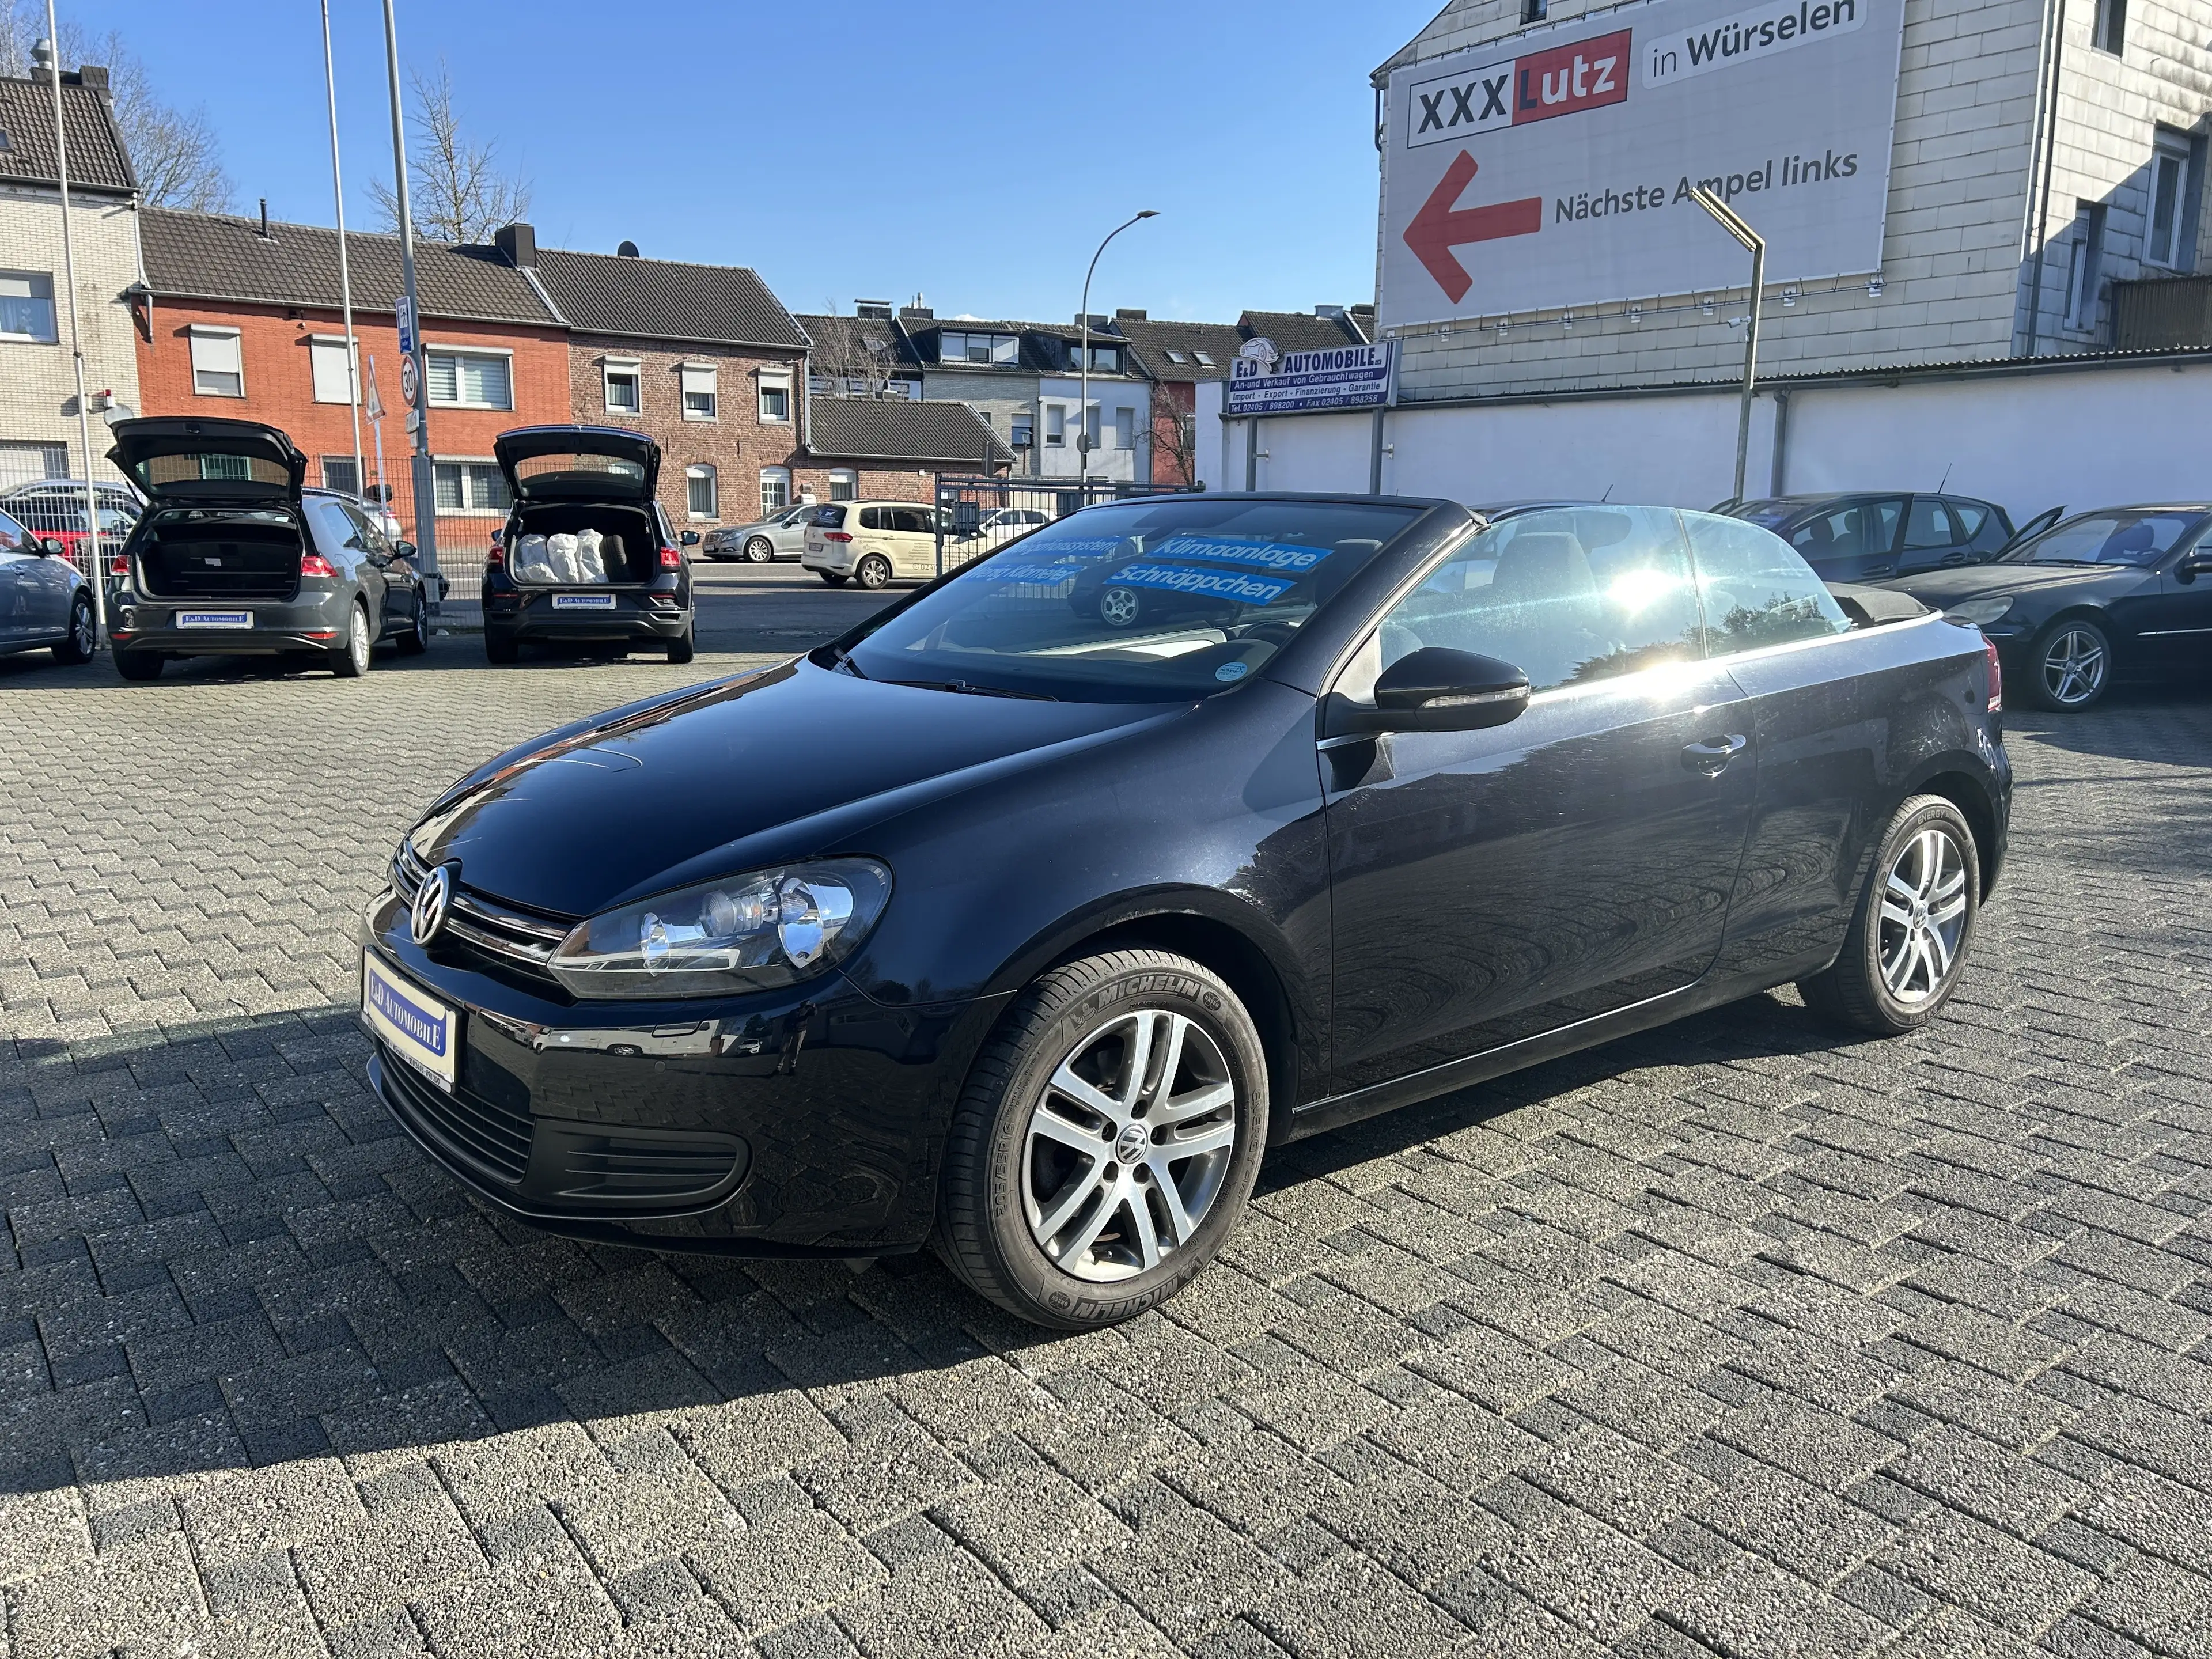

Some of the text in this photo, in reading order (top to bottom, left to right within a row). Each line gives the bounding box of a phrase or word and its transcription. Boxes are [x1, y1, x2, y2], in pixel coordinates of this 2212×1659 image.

[1653, 0, 1855, 78] in Würselen
[1556, 149, 1858, 224] Nächste Ampel links
[1236, 347, 1376, 378] E&D AUTOMOBILE
[404, 369, 413, 393] 30
[1233, 392, 1255, 402] Import
[1264, 390, 1288, 400] Export
[1295, 385, 1341, 396] Finanzierung
[1349, 382, 1381, 392] Garantie
[1263, 377, 1290, 387] Verkauf
[1309, 371, 1374, 383] Gebrauchtwagen
[1231, 404, 1242, 412] Tel.
[1243, 403, 1263, 412] 02405
[1269, 401, 1295, 410] 898200
[1306, 399, 1321, 407] Fax
[1321, 397, 1343, 406] 02405
[1350, 395, 1378, 404] 898258
[1154, 539, 1317, 567] Klimaanlage
[1111, 565, 1282, 600] Schnäppchen
[1917, 809, 1945, 825] ENERGY
[1098, 975, 1200, 1009] MICHELIN
[370, 975, 441, 1051] E&D AUTOMOBILE
[1248, 1088, 1262, 1166] ENERGY
[1070, 1276, 1179, 1320] MICHELIN
